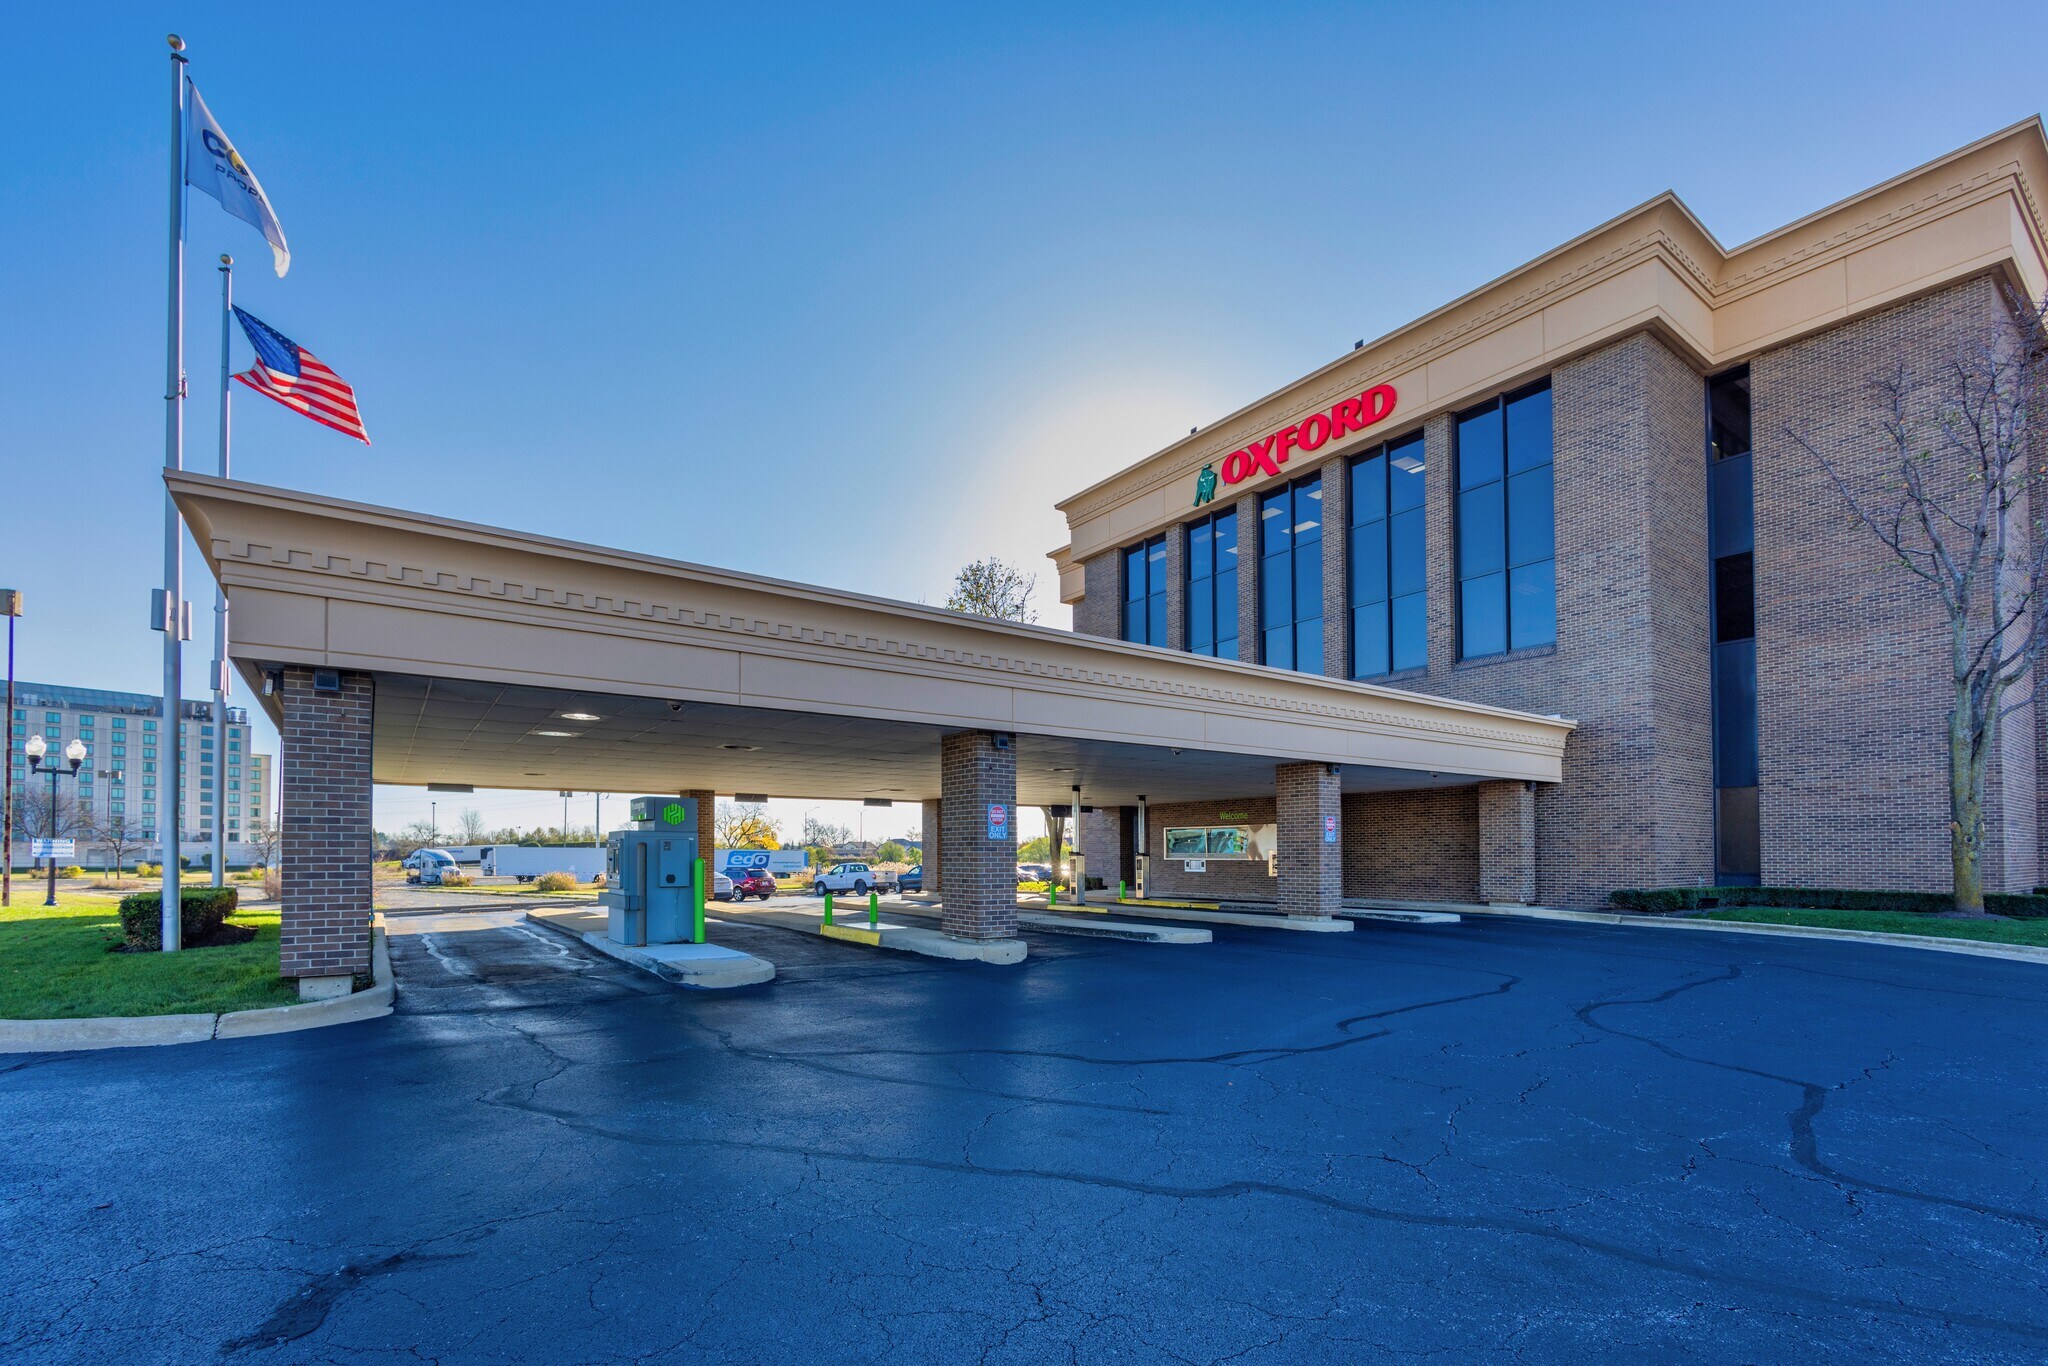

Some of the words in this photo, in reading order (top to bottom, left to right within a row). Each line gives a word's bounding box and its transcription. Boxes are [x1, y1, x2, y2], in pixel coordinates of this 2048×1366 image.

[1221, 384, 1397, 484] OXFORD
[1220, 811, 1248, 820] Welcome
[730, 853, 768, 867] ego
